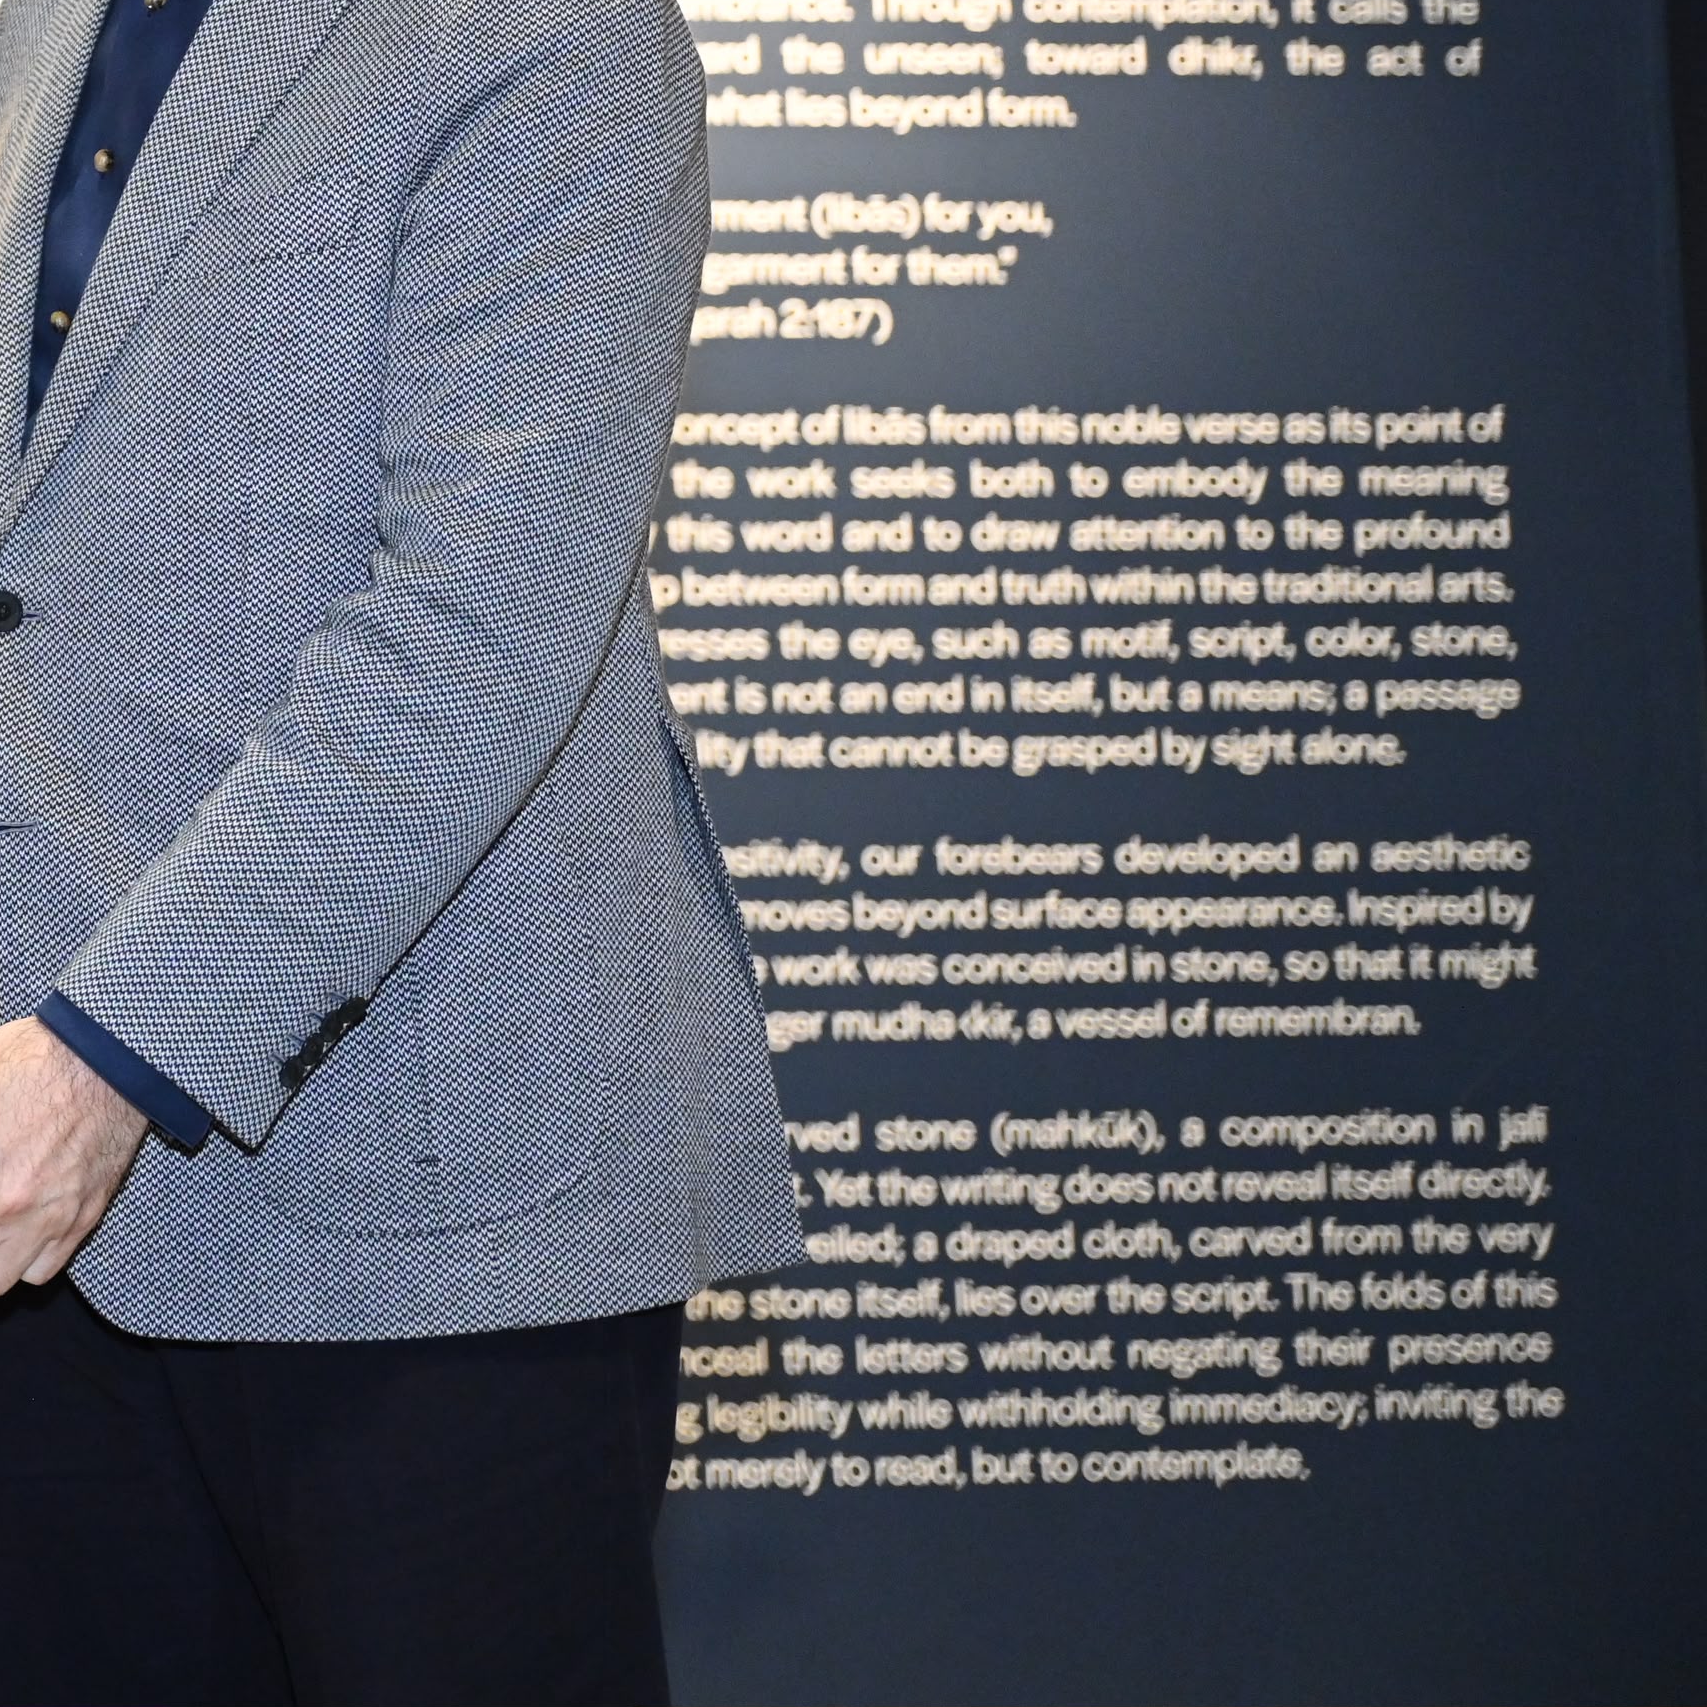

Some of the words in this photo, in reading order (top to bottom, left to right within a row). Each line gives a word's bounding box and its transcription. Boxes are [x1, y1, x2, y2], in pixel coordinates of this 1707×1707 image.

[673, 458, 733, 500] the
[746, 458, 835, 499] work
[851, 458, 955, 500] seeks
[969, 458, 1054, 499] both
[1069, 462, 1108, 499] to
[1122, 457, 1267, 505] embody
[1283, 457, 1342, 497] the
[1359, 458, 1509, 506] meaning
[666, 511, 733, 553] this
[740, 511, 833, 553] word
[842, 512, 912, 553] and
[923, 516, 962, 553] to
[970, 511, 1059, 552] draw
[1070, 512, 1225, 552] attention
[1235, 515, 1274, 552] to
[1284, 510, 1343, 550] the
[1354, 509, 1510, 557] profound
[735, 675, 766, 715] is
[772, 677, 833, 715] not
[840, 681, 887, 715] an
[893, 673, 964, 715] end
[971, 675, 1004, 713] in
[1011, 671, 1103, 717] itself,
[1110, 672, 1170, 713] but
[1178, 680, 1202, 713] a
[1210, 679, 1336, 715] means;
[1344, 678, 1368, 711] a
[1375, 678, 1520, 720] passage
[875, 1115, 976, 1152] stone
[1180, 1116, 1205, 1148] a
[1220, 1108, 1436, 1154] composition
[1452, 1112, 1484, 1144] in
[686, 1285, 745, 1324] the
[750, 1284, 851, 1321] stone
[857, 1278, 947, 1322] itself,
[955, 1277, 1016, 1317] lies
[1020, 1284, 1099, 1316] over
[1106, 1275, 1166, 1315] the
[1172, 1275, 1279, 1320] script.
[1291, 1271, 1354, 1312] The
[1360, 1270, 1445, 1311] folds
[1451, 1269, 1486, 1309] of
[1494, 1270, 1558, 1309] this
[705, 1449, 826, 1498] merely
[831, 1452, 870, 1488] to
[874, 1446, 967, 1490] read,
[972, 1446, 1034, 1485] but
[1039, 1448, 1078, 1484] to
[1082, 1440, 1309, 1488] contemplate.
